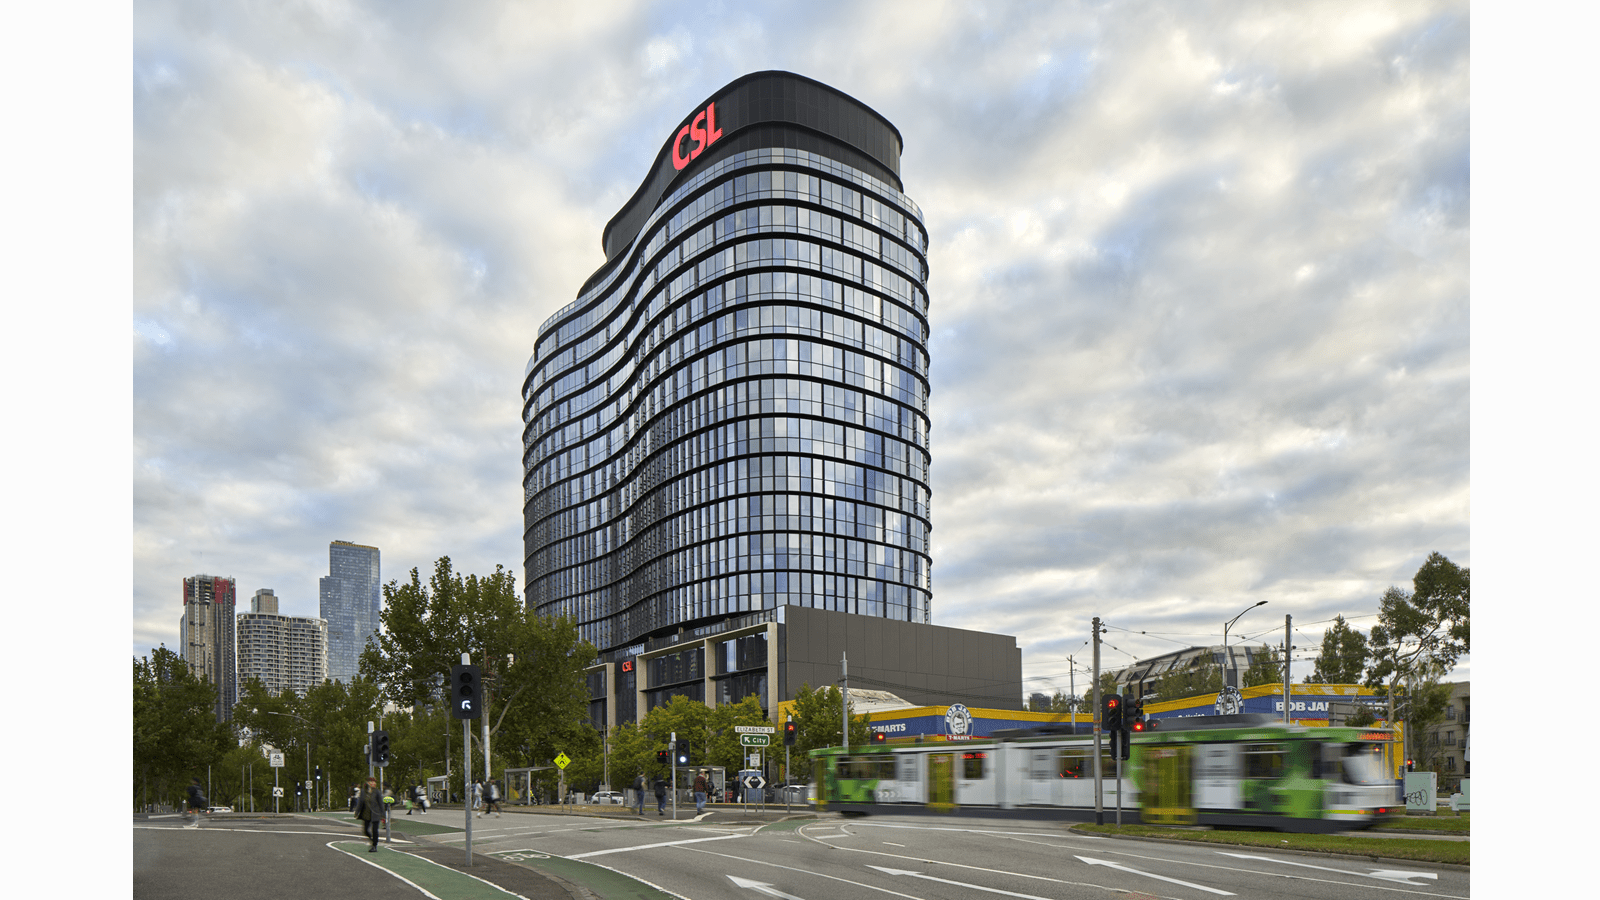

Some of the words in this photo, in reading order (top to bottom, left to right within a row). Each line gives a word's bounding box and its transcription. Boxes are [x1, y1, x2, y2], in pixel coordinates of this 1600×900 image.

[672, 101, 723, 170] CSL
[622, 660, 633, 672] CSL
[1275, 701, 1306, 712] BOB
[945, 706, 957, 723] BOB
[957, 705, 972, 724] JANE
[752, 737, 767, 745] City
